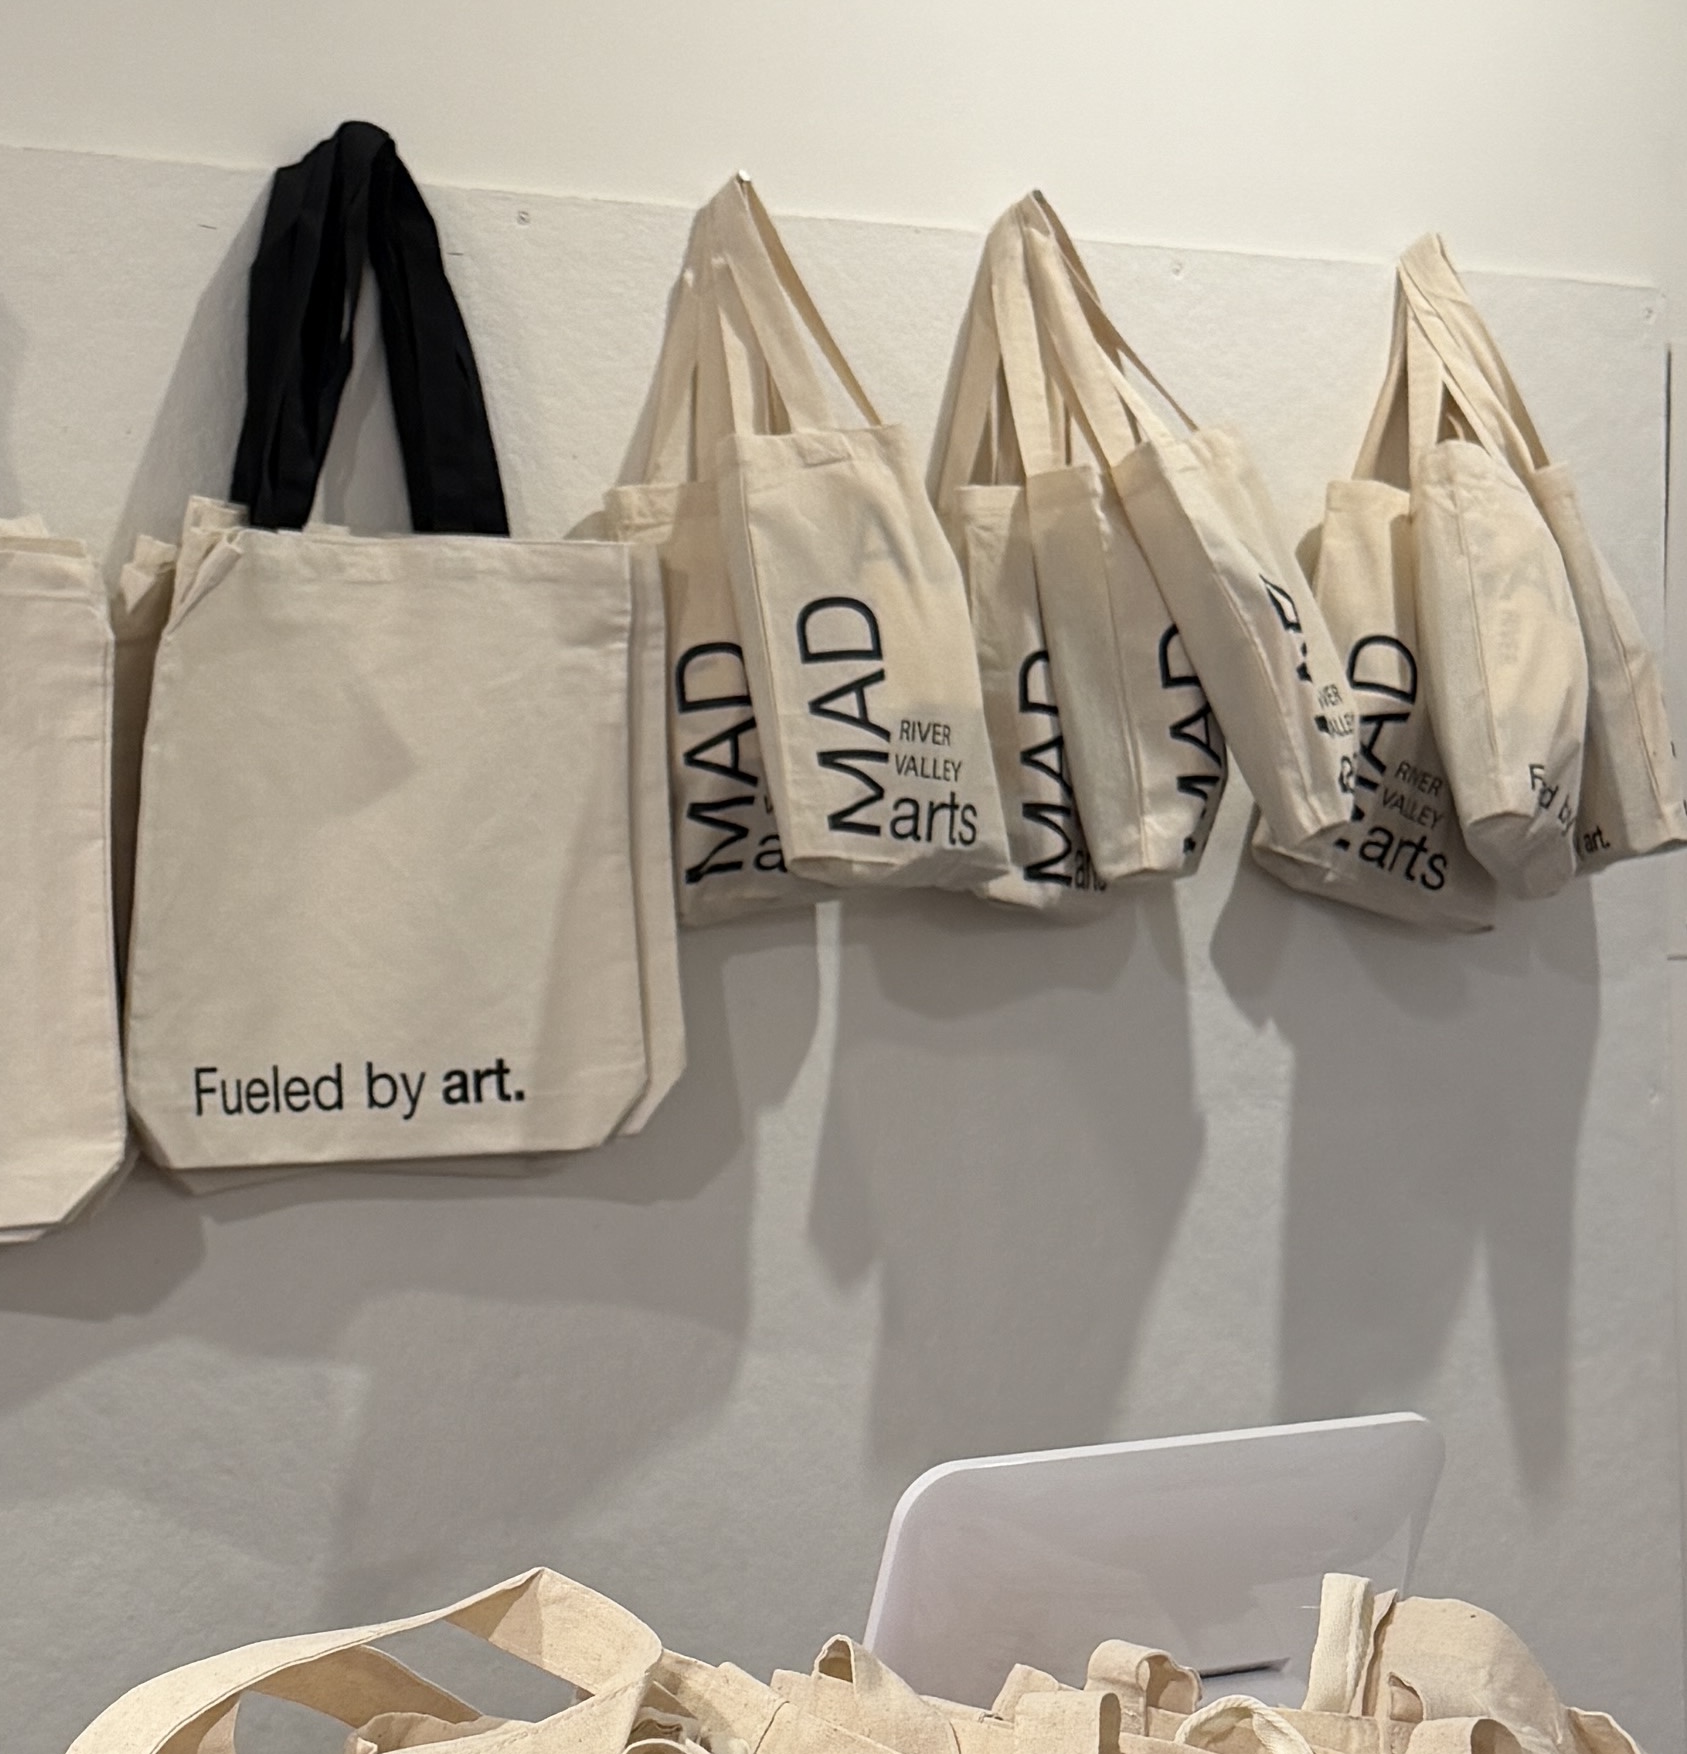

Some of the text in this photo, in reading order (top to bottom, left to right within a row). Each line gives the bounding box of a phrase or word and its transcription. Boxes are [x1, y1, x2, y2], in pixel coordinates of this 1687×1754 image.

[796, 596, 891, 837] MAD
[899, 719, 952, 747] RIVER
[675, 641, 759, 884] MAD
[895, 753, 963, 783] VALLEY
[889, 791, 979, 847] arts
[1382, 787, 1445, 830] VALLEY
[1358, 826, 1448, 891] arts
[193, 1057, 527, 1121] Fueled by art.
